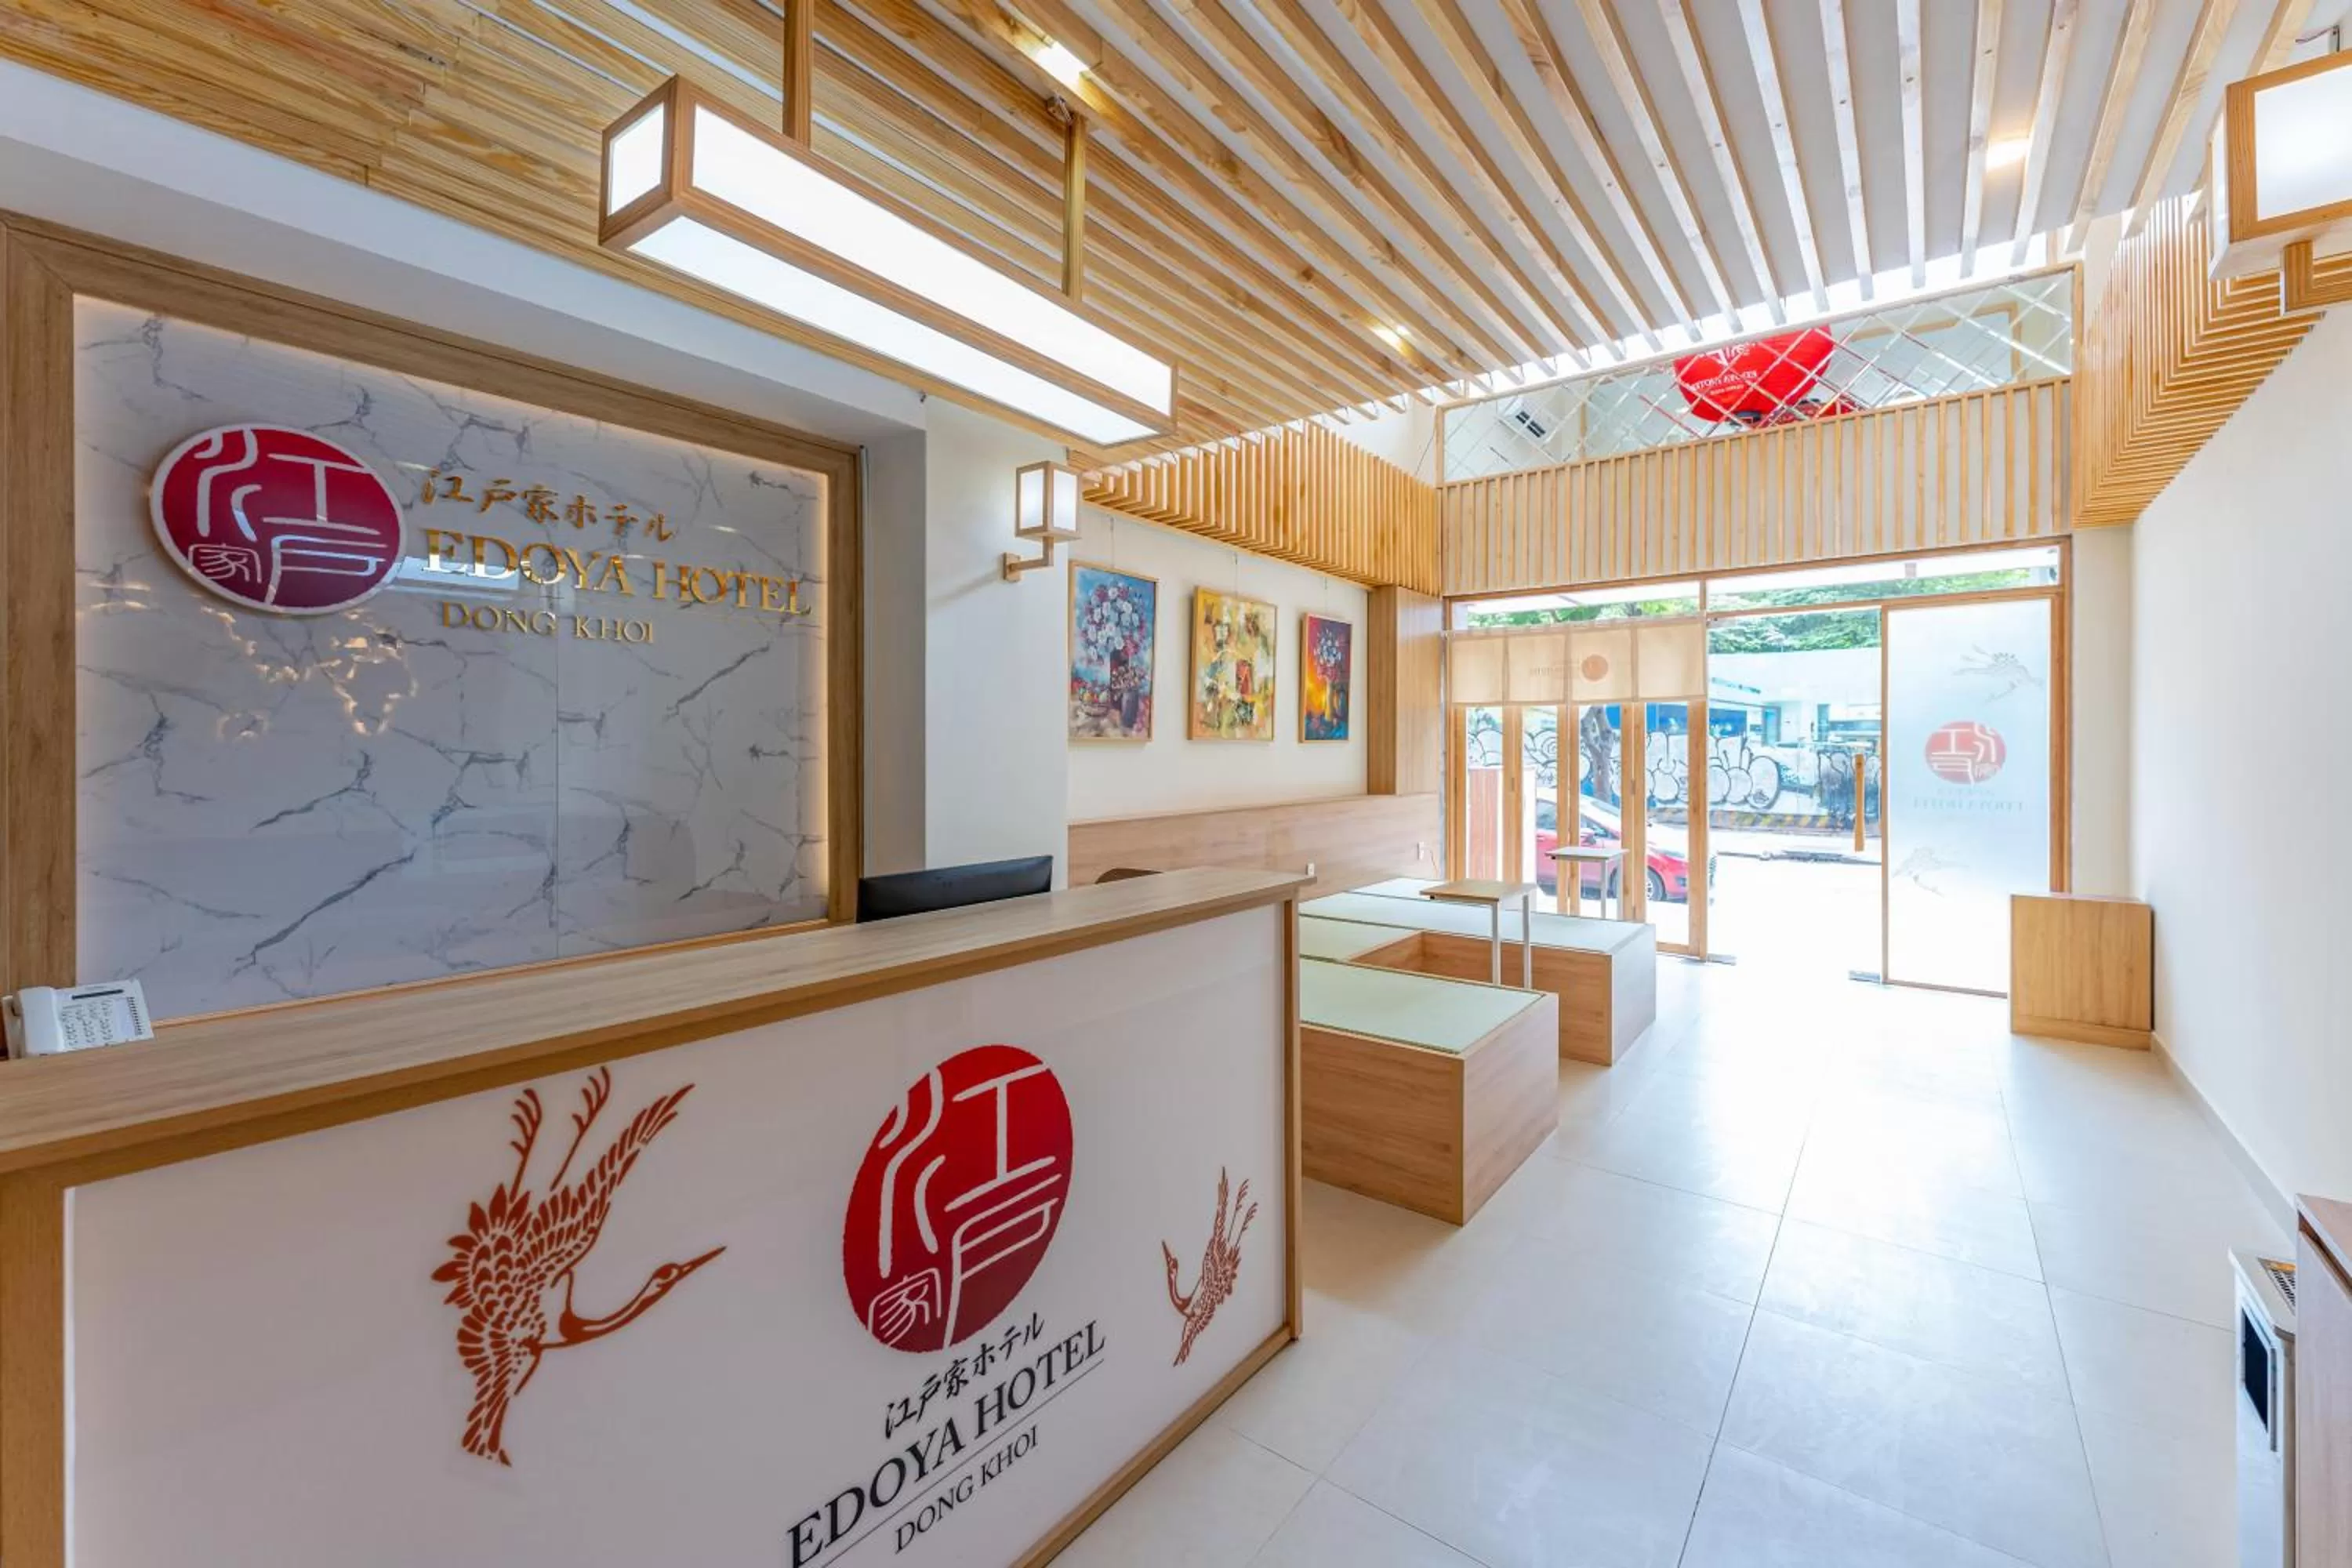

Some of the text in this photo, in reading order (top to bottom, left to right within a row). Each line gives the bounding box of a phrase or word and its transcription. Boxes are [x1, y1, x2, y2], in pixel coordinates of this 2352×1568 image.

[420, 528, 812, 617] EDOYA HOTEL
[442, 601, 655, 644] DONG KHOI
[884, 1312, 1044, 1439] 江戸家ホテル
[786, 1320, 1105, 1568] EDOYA HOTEL
[895, 1425, 1039, 1554] DONG KHOI
